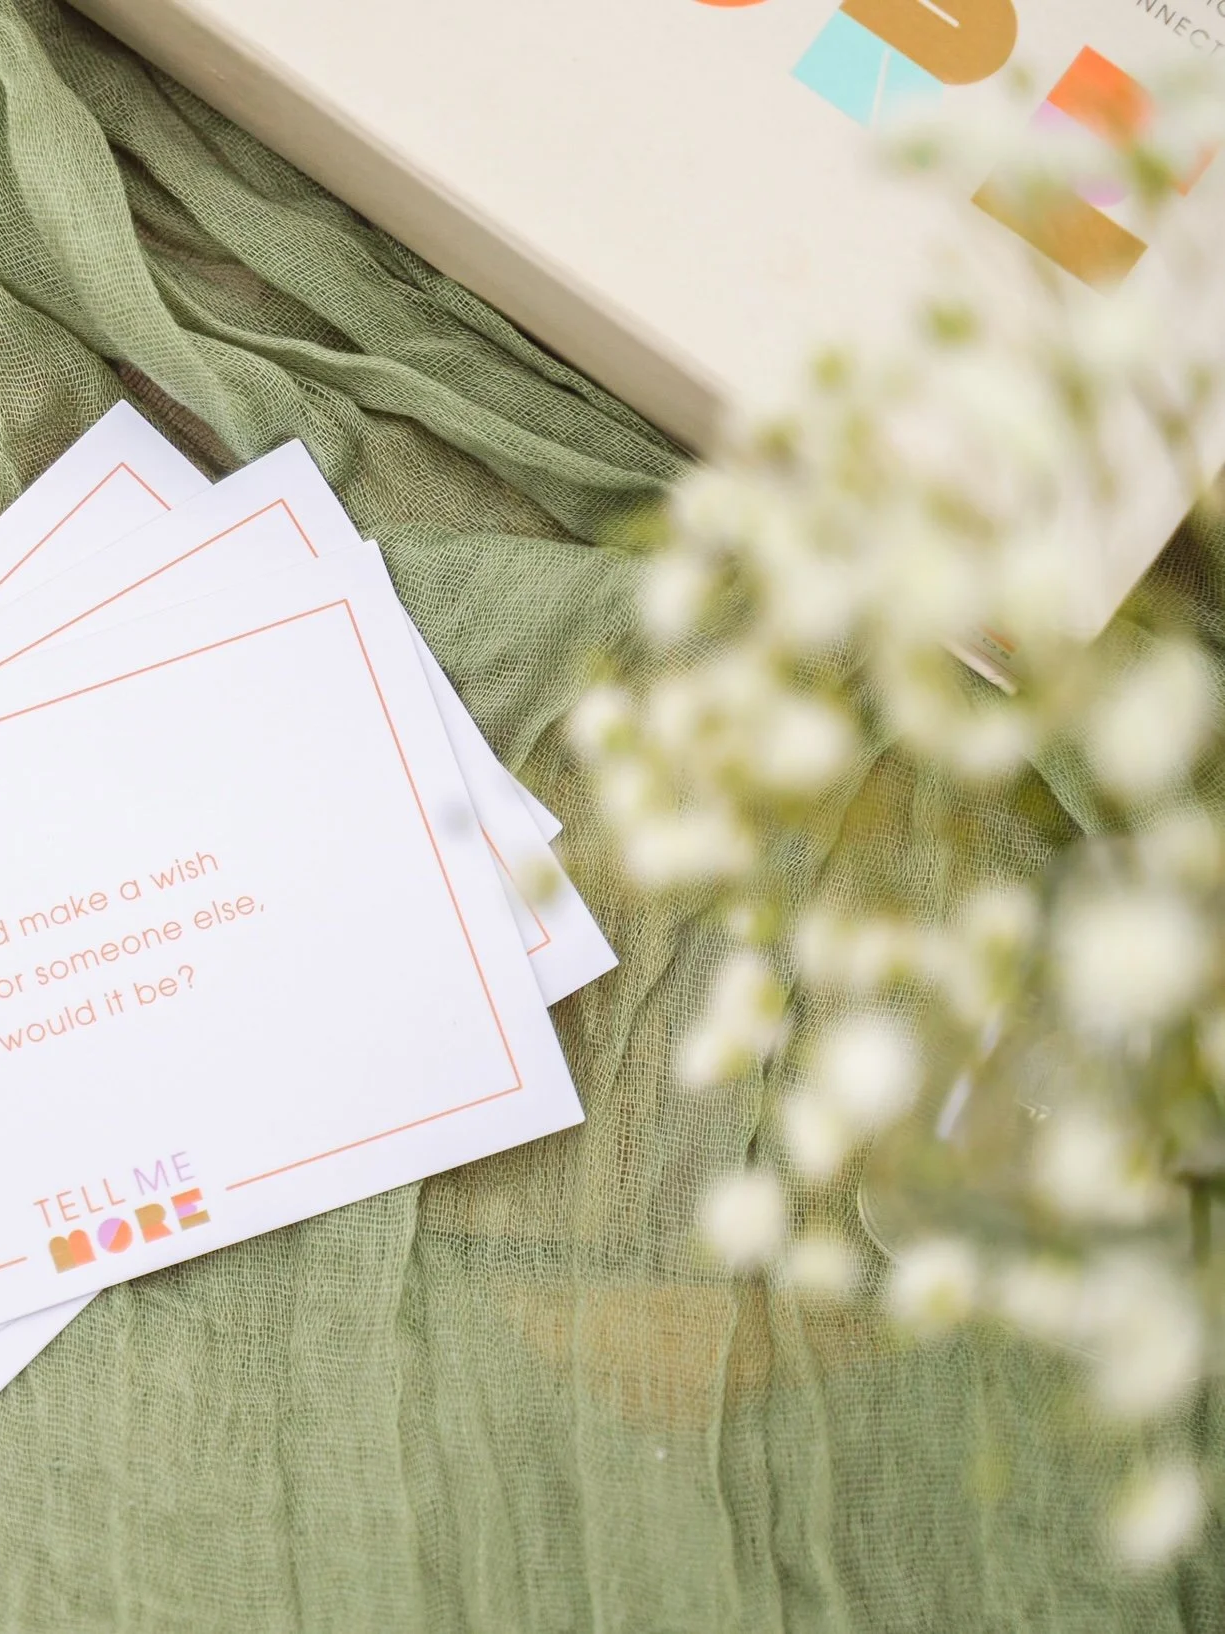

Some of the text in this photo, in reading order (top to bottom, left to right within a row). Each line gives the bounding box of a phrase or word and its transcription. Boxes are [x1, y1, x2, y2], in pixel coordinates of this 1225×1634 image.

[18, 890, 109, 936] make
[118, 879, 143, 901] a
[149, 851, 220, 892] wish
[34, 919, 184, 986] someone
[192, 894, 266, 931] else,
[104, 988, 125, 1016] it
[133, 963, 196, 1007] be?
[33, 1151, 196, 1228] TELL ME
[47, 1187, 212, 1275] MORE
